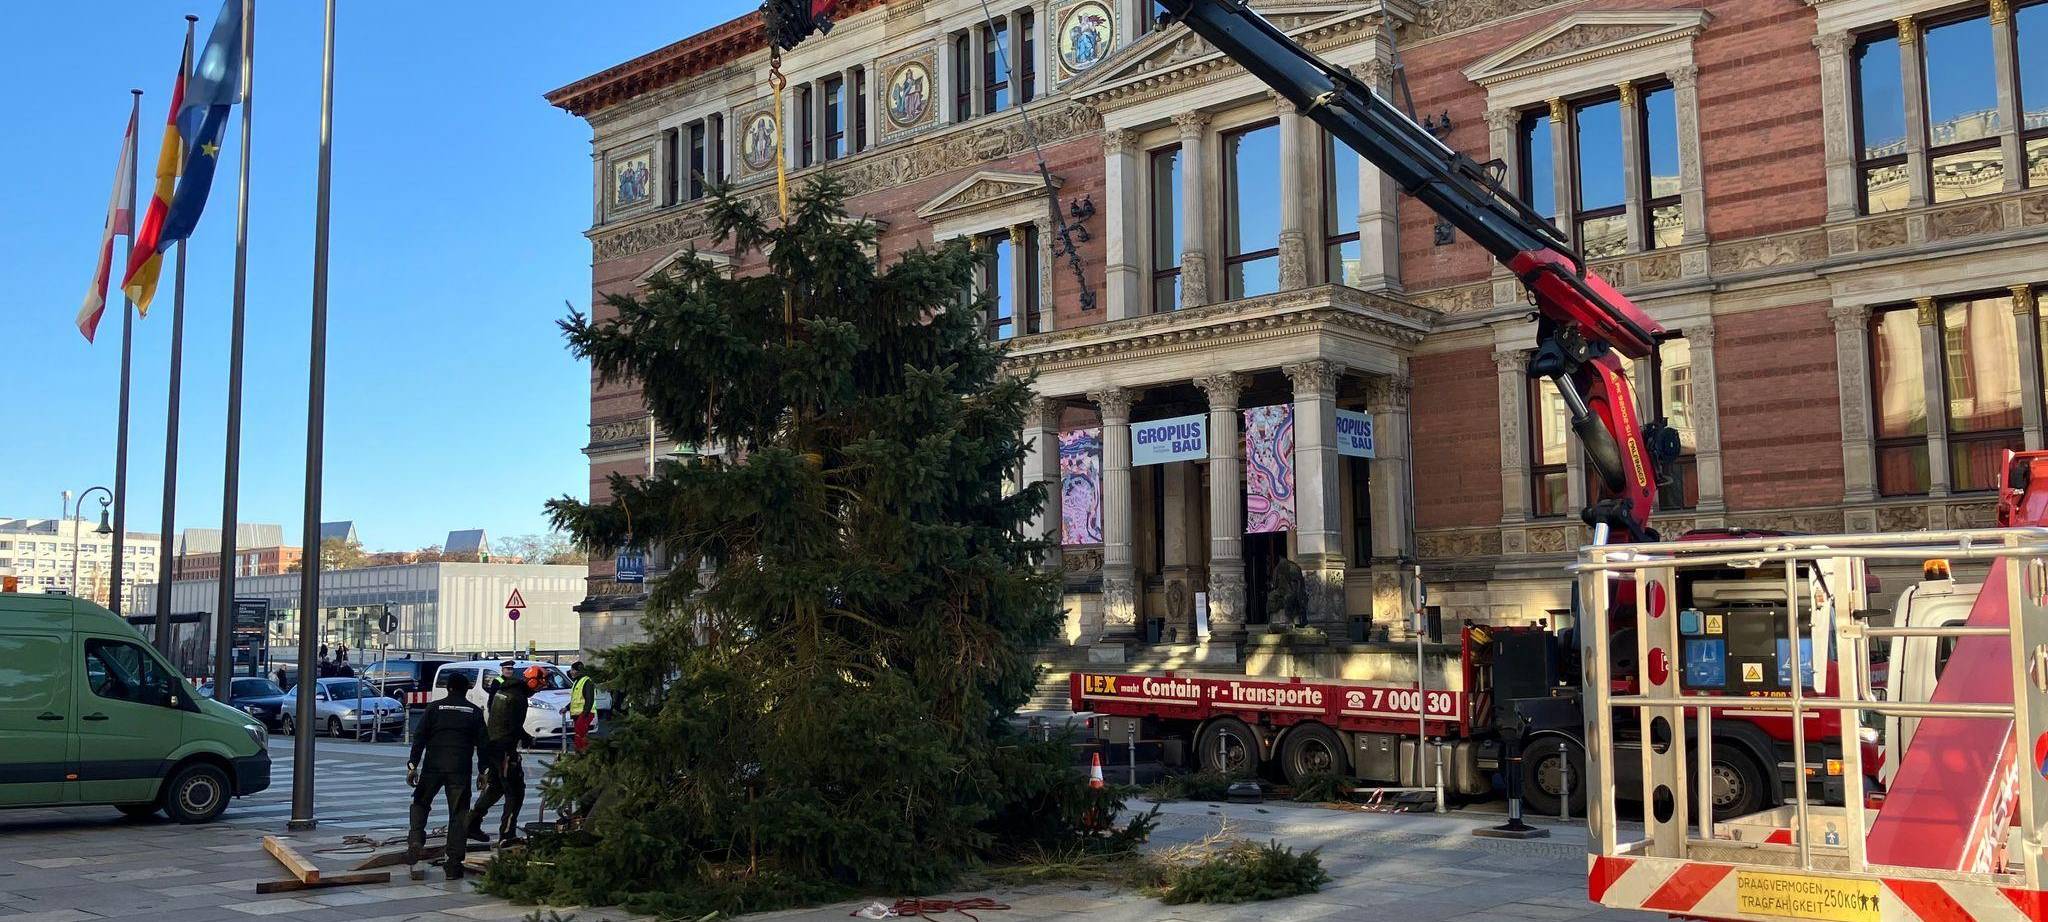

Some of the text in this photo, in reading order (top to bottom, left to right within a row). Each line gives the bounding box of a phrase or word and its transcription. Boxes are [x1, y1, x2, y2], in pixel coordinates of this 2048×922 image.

[1137, 421, 1201, 445] GROPIUS
[1336, 416, 1371, 437] ROPIUS
[1171, 438, 1202, 453] BAU
[1351, 436, 1372, 450] BAU
[1085, 675, 1117, 694] LEX
[1120, 683, 1140, 693] macht
[1371, 689, 1384, 709] 7
[1387, 690, 1421, 712] 000
[1427, 692, 1452, 713] 30
[1738, 877, 1823, 895] DRAAGVERMOGEN
